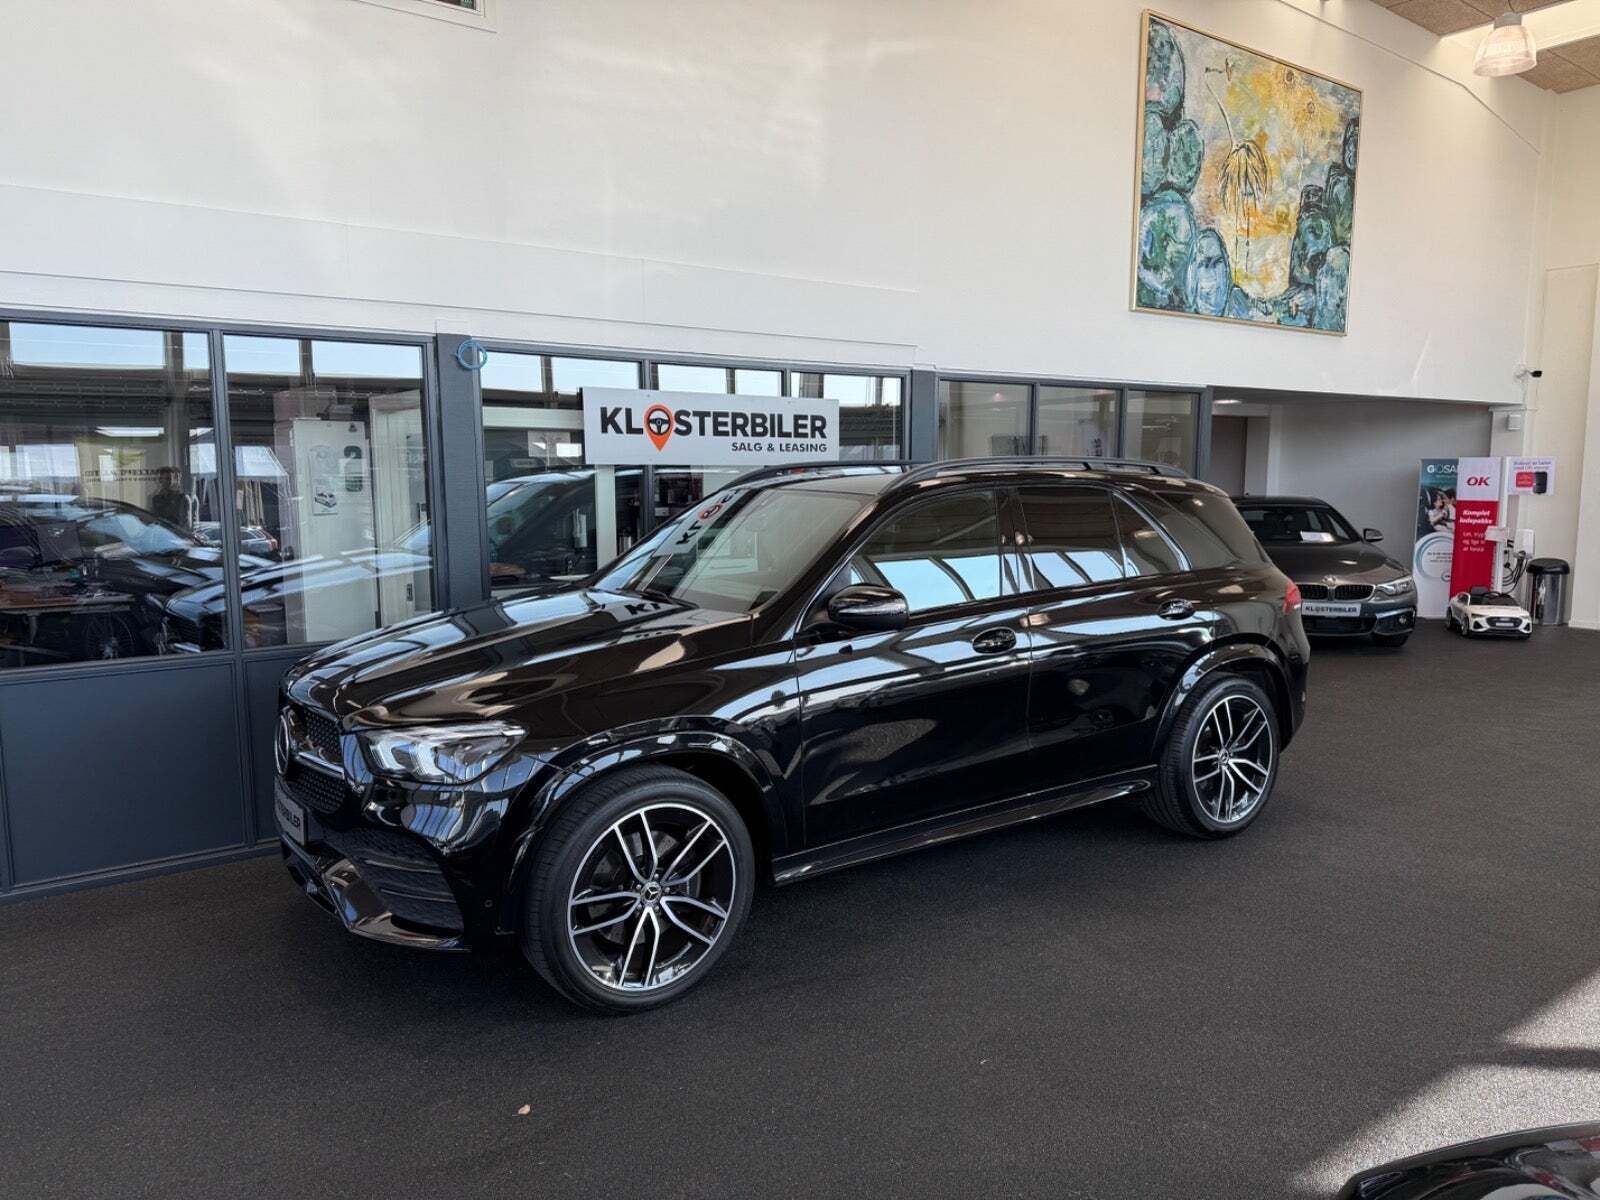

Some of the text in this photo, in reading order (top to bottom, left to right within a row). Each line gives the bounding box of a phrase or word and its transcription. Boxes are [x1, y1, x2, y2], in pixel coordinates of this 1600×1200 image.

[600, 405, 827, 441] KLOSTERBILER
[731, 442, 827, 453] SALG & LEASING
[1467, 476, 1490, 486] OK
